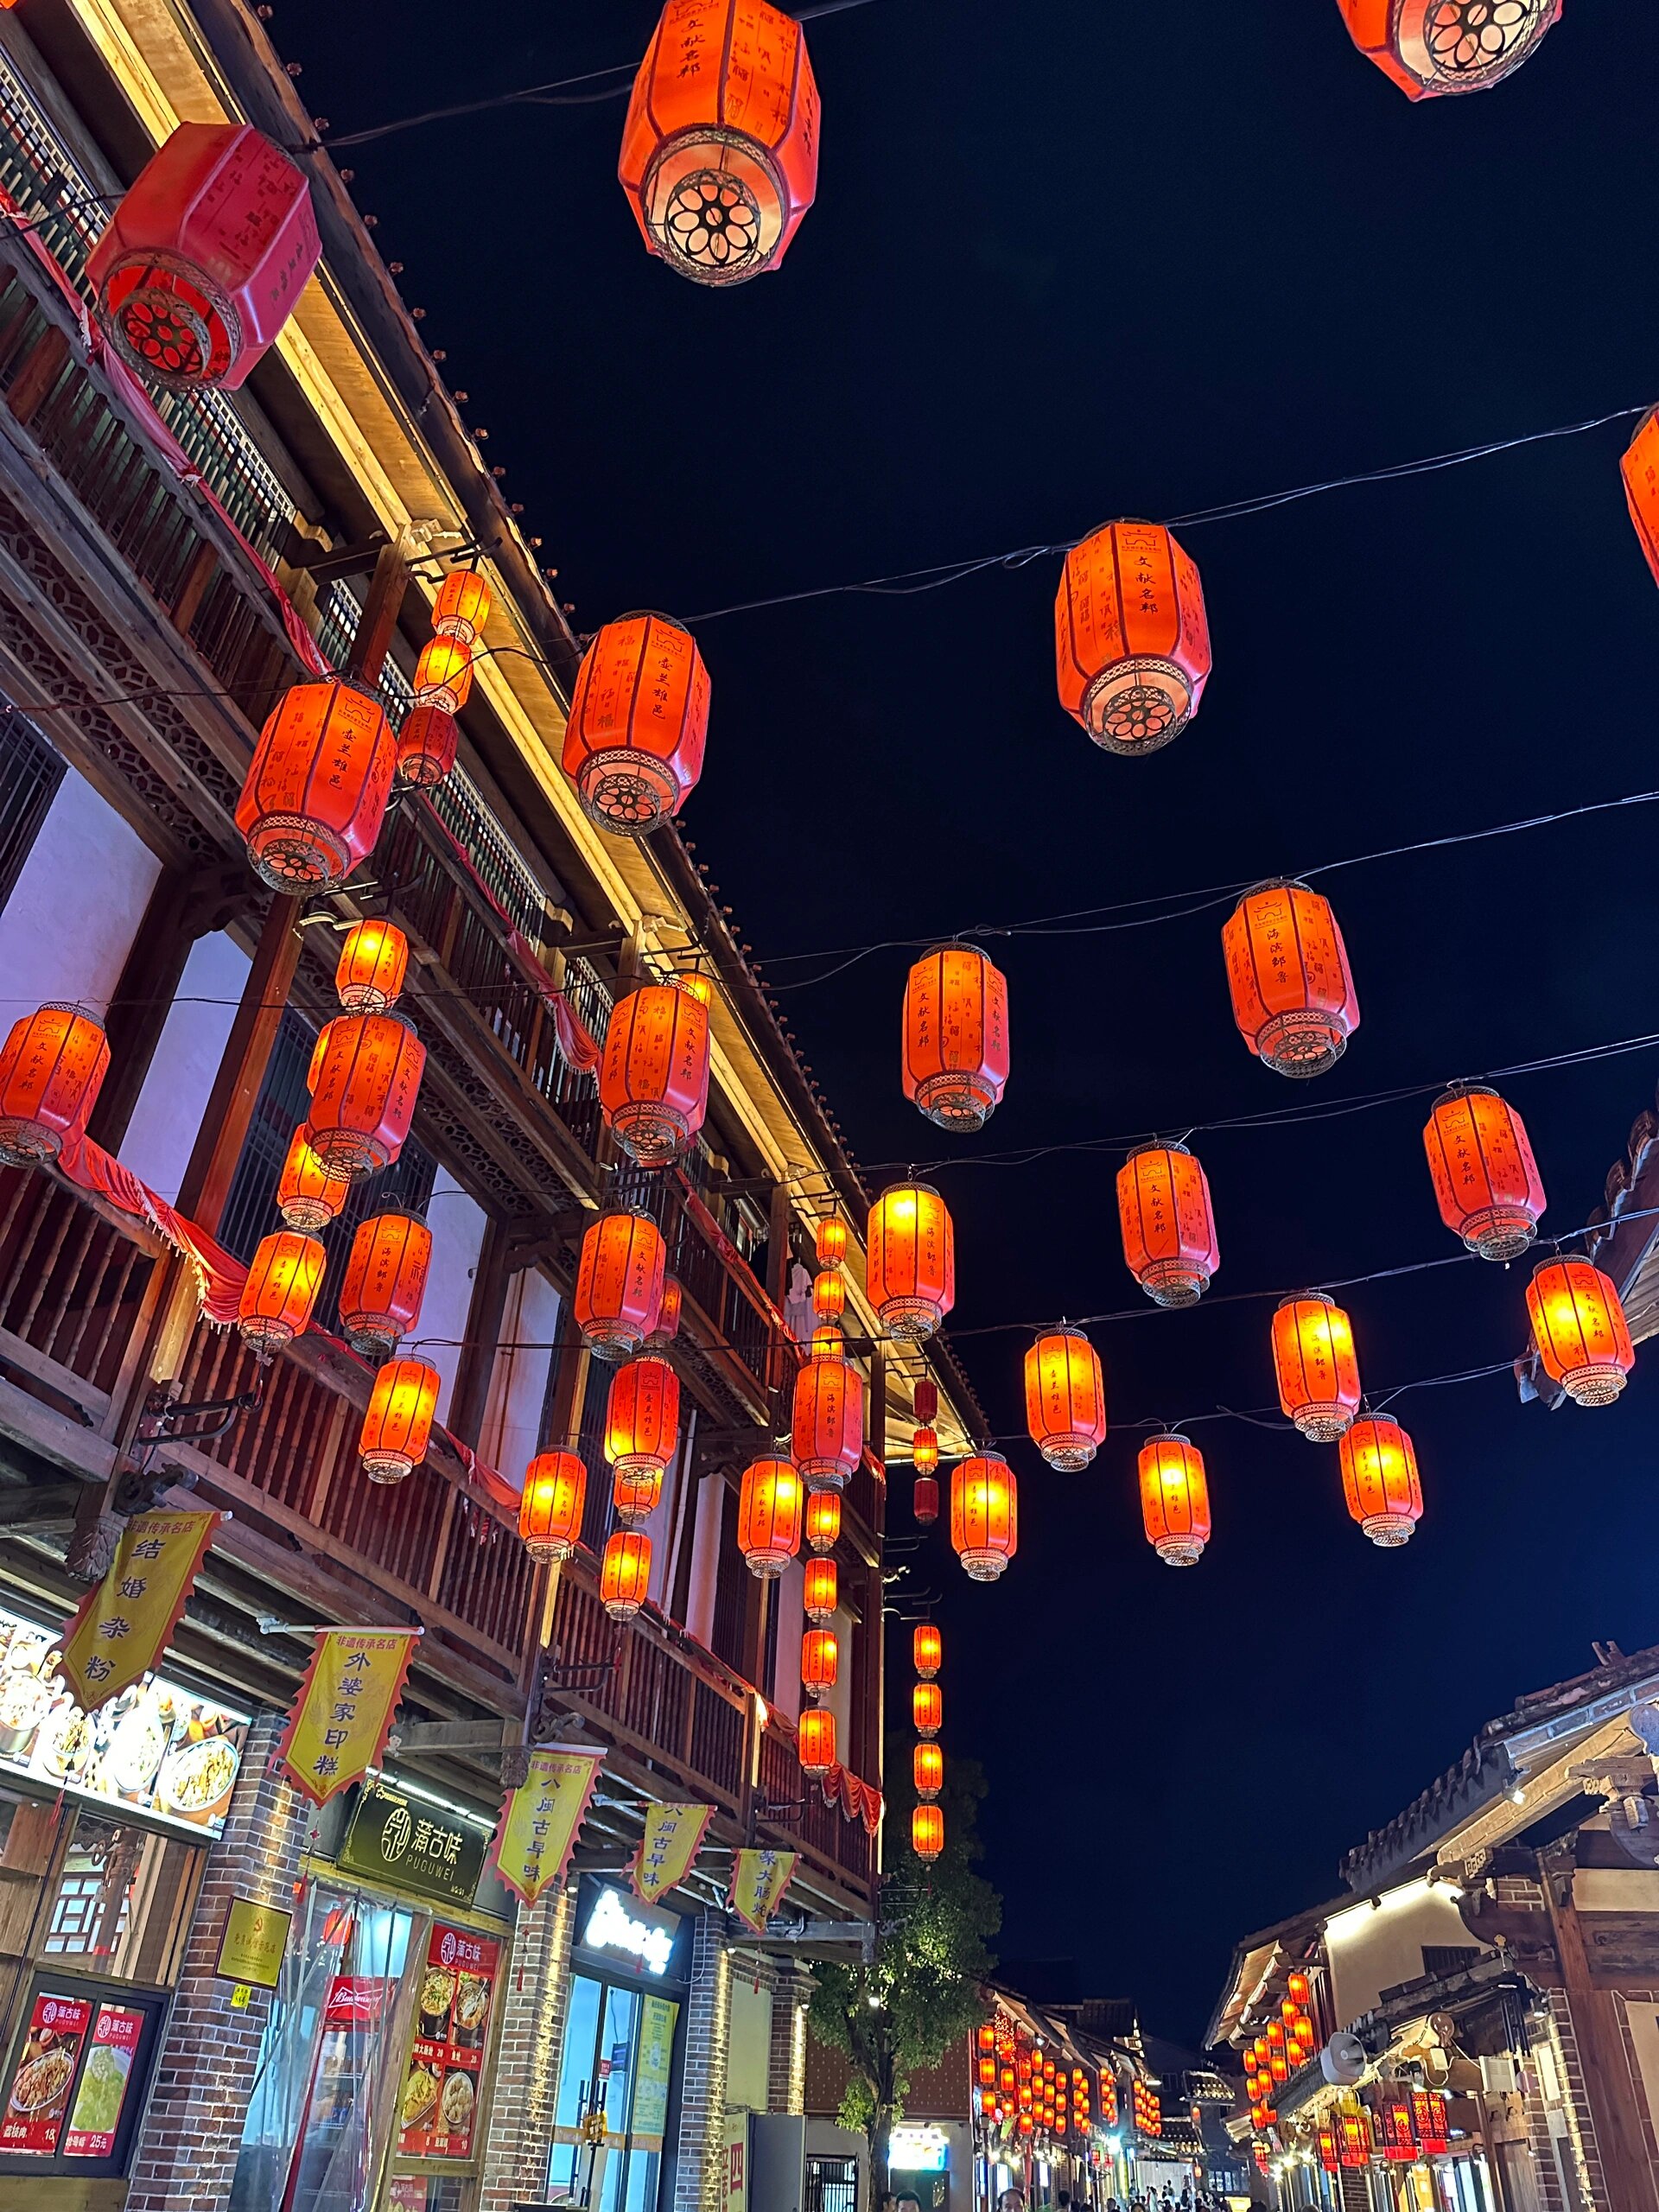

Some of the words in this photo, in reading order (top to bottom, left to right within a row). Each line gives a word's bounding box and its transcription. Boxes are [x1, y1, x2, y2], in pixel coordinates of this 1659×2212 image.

[677, 18, 705, 79] 文献名邦
[1134, 556, 1159, 615] 文献名邦
[651, 658, 673, 720] 壶兰雄邑
[328, 728, 357, 790] 壶兰雄邑
[1267, 928, 1289, 983] 海滨邹鲁
[917, 992, 931, 1048] 文献名邦
[19, 1042, 48, 1090] 文献名邦
[321, 1050, 345, 1102] 文献名邦
[680, 1027, 696, 1081] 文献名邦
[1453, 1135, 1476, 1186] 文献名邦
[1149, 1184, 1166, 1234] 文献名邦
[373, 1247, 391, 1293] 海滨邹鲁
[632, 1251, 646, 1297] 文献名邦
[1585, 1293, 1605, 1339] 文献名邦
[84, 1539, 166, 1682] 结婚杂粉
[336, 1636, 397, 1649] 非遗传承名店
[313, 1652, 371, 1777] 外婆家印糕
[531, 1760, 582, 1774] 非遗传承名店
[523, 1778, 561, 1883] 八闽古早味
[644, 1808, 683, 1886] 八闽古早味
[406, 1853, 455, 1882] PUGUWEI
[90, 2134, 107, 2149] 25元
